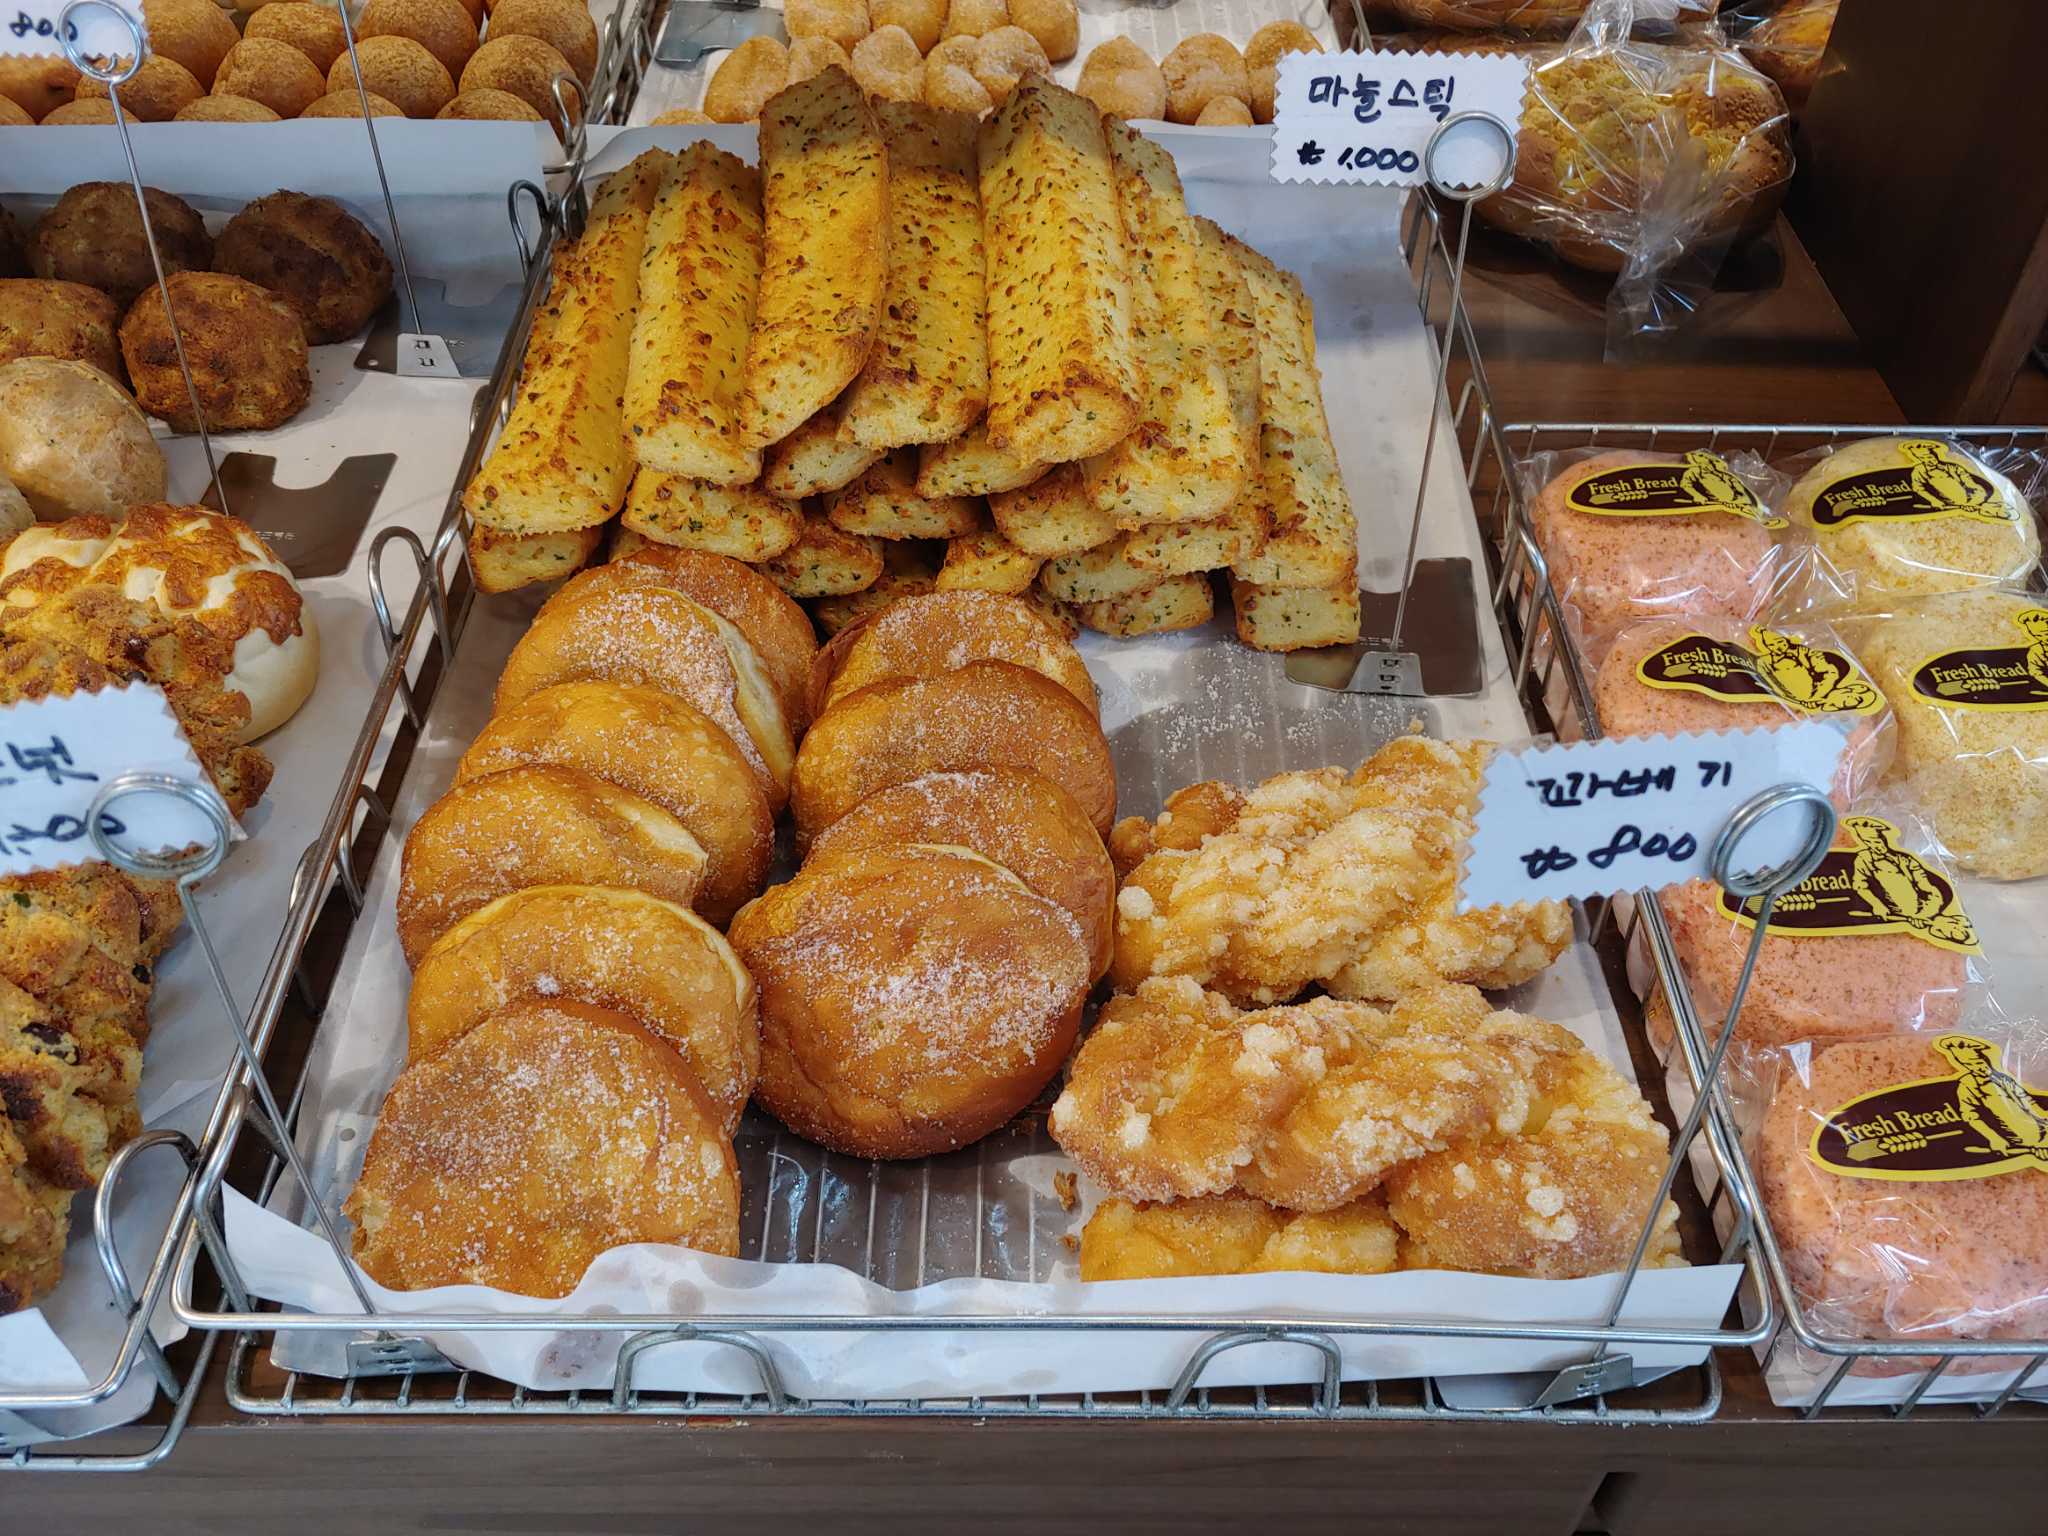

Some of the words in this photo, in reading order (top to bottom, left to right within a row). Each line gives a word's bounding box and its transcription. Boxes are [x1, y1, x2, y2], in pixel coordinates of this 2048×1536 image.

[1308, 73, 1455, 123] 마늘스틱
[1588, 480, 1632, 495] Fresh
[1633, 477, 1679, 490] Bread
[1823, 486, 1868, 507] Fresh
[1866, 480, 1912, 496] Bread
[1662, 647, 1710, 667] Fresh
[1712, 648, 1757, 671] Bread
[1930, 663, 1979, 684] Fresh
[1977, 662, 2028, 679] Bread
[1840, 1114, 1900, 1146] Fresh
[1893, 1102, 1961, 1131] Bread
